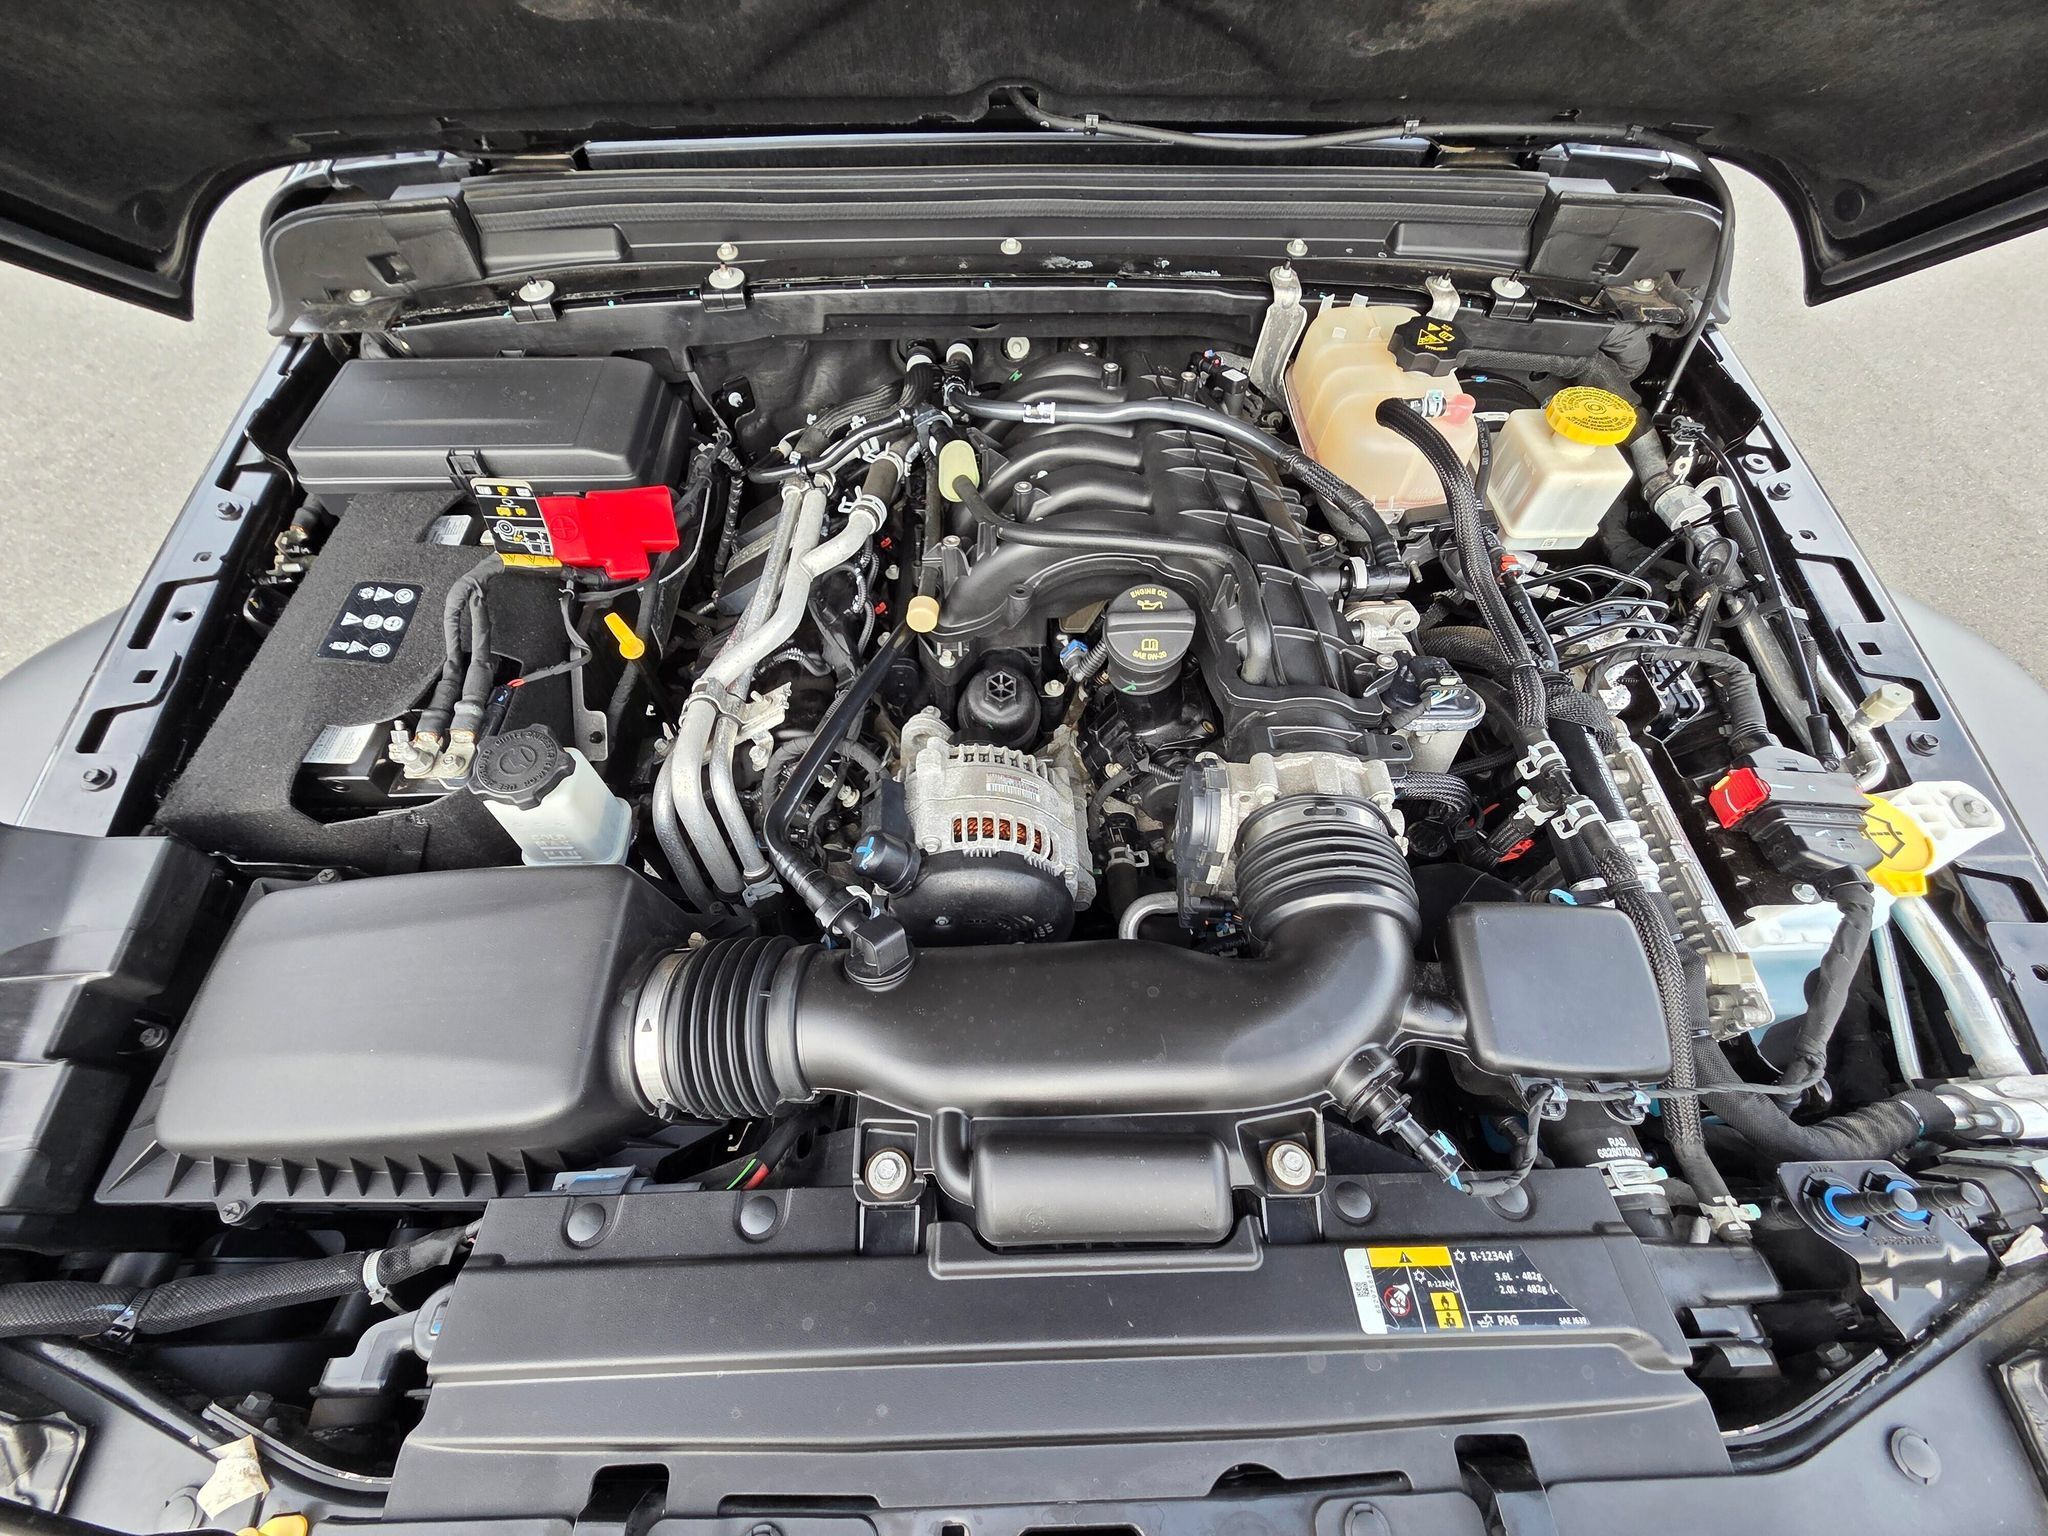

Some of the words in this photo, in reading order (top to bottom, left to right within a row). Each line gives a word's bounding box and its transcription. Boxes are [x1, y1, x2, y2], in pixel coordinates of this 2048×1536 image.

[1130, 588, 1157, 598] ENGINE
[1157, 589, 1168, 599] OIL
[1132, 650, 1146, 660] SAE
[1607, 1137, 1627, 1147] RAD
[1470, 1250, 1514, 1264] R-1234yf
[1494, 1272, 1513, 1282] 3.6L
[1522, 1271, 1544, 1282] 482g
[1498, 1285, 1517, 1294] 2.0L
[1526, 1284, 1548, 1295] 482g
[1497, 1315, 1519, 1326] PAG
[1558, 1316, 1572, 1325] SAE
